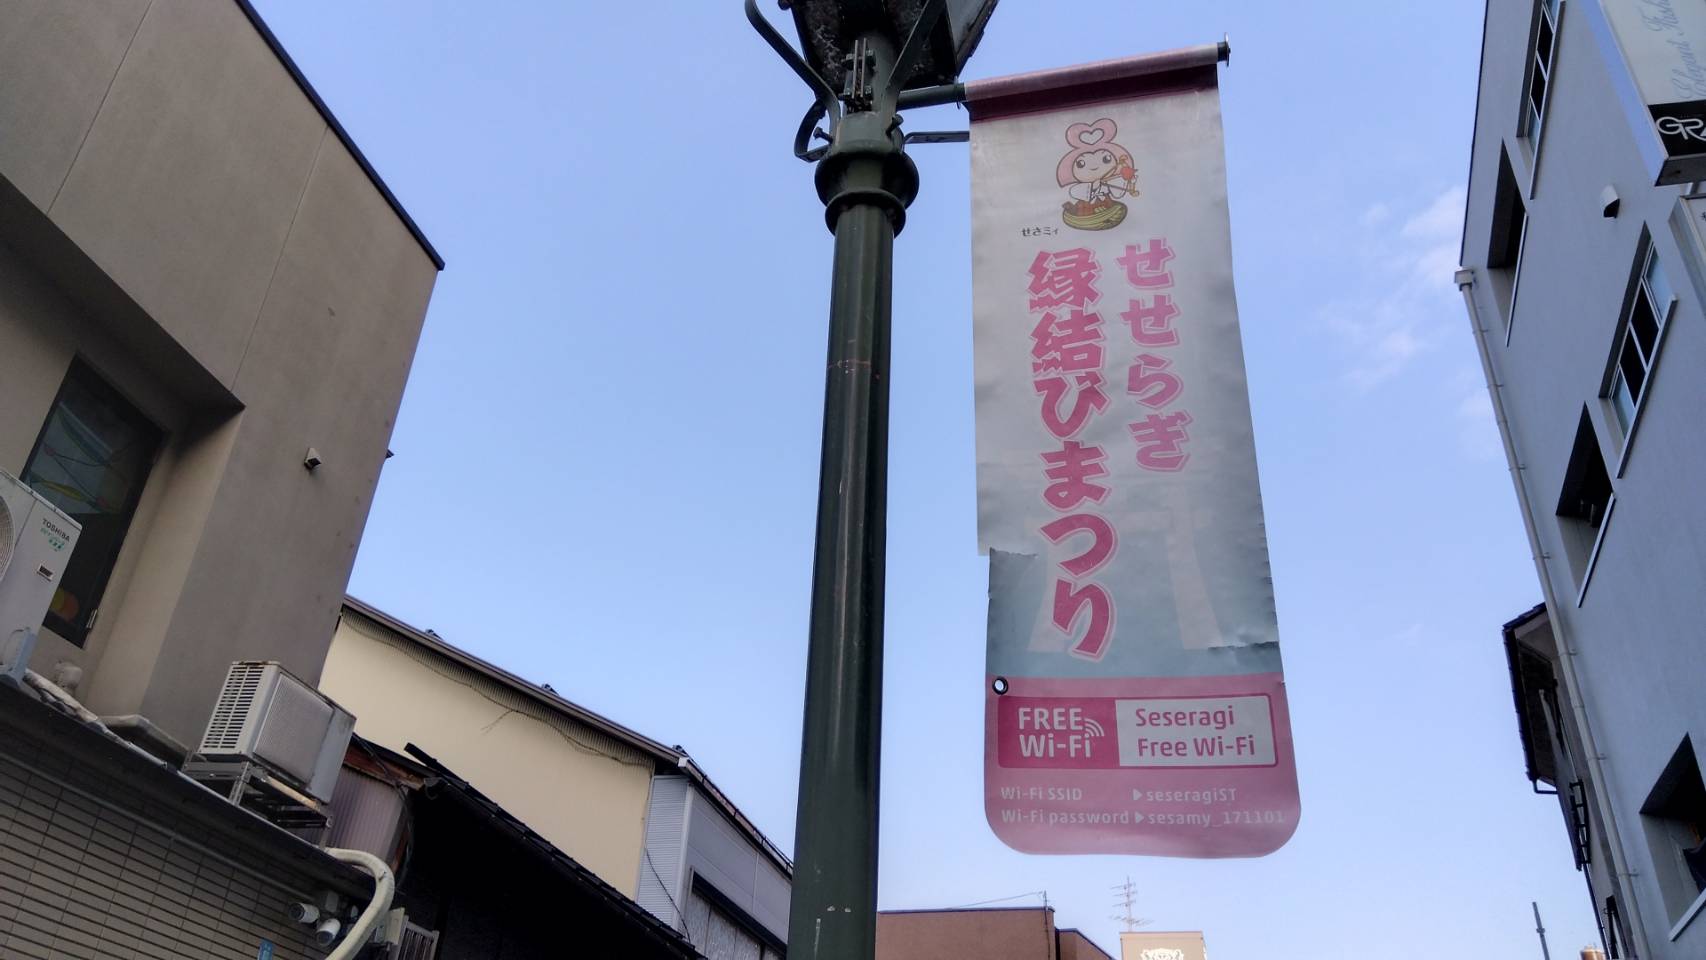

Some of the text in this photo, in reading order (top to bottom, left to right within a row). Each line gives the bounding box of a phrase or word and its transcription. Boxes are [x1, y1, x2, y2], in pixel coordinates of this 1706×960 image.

[1656, 116, 1706, 141] GR
[1116, 238, 1193, 472] せせらぎ
[1027, 247, 1118, 662] 縁結びまつり
[42, 519, 70, 542] TOSHIBA
[1018, 707, 1083, 731] FREE
[1135, 705, 1234, 730] Seseragi
[1019, 733, 1091, 759] Wi-Fi
[1138, 734, 1255, 757] Free Wi-Fi
[1001, 786, 1237, 805] Wi-Fi SSID seseragiST
[1001, 809, 1286, 827] Wi-Fi password sesamy_171101
